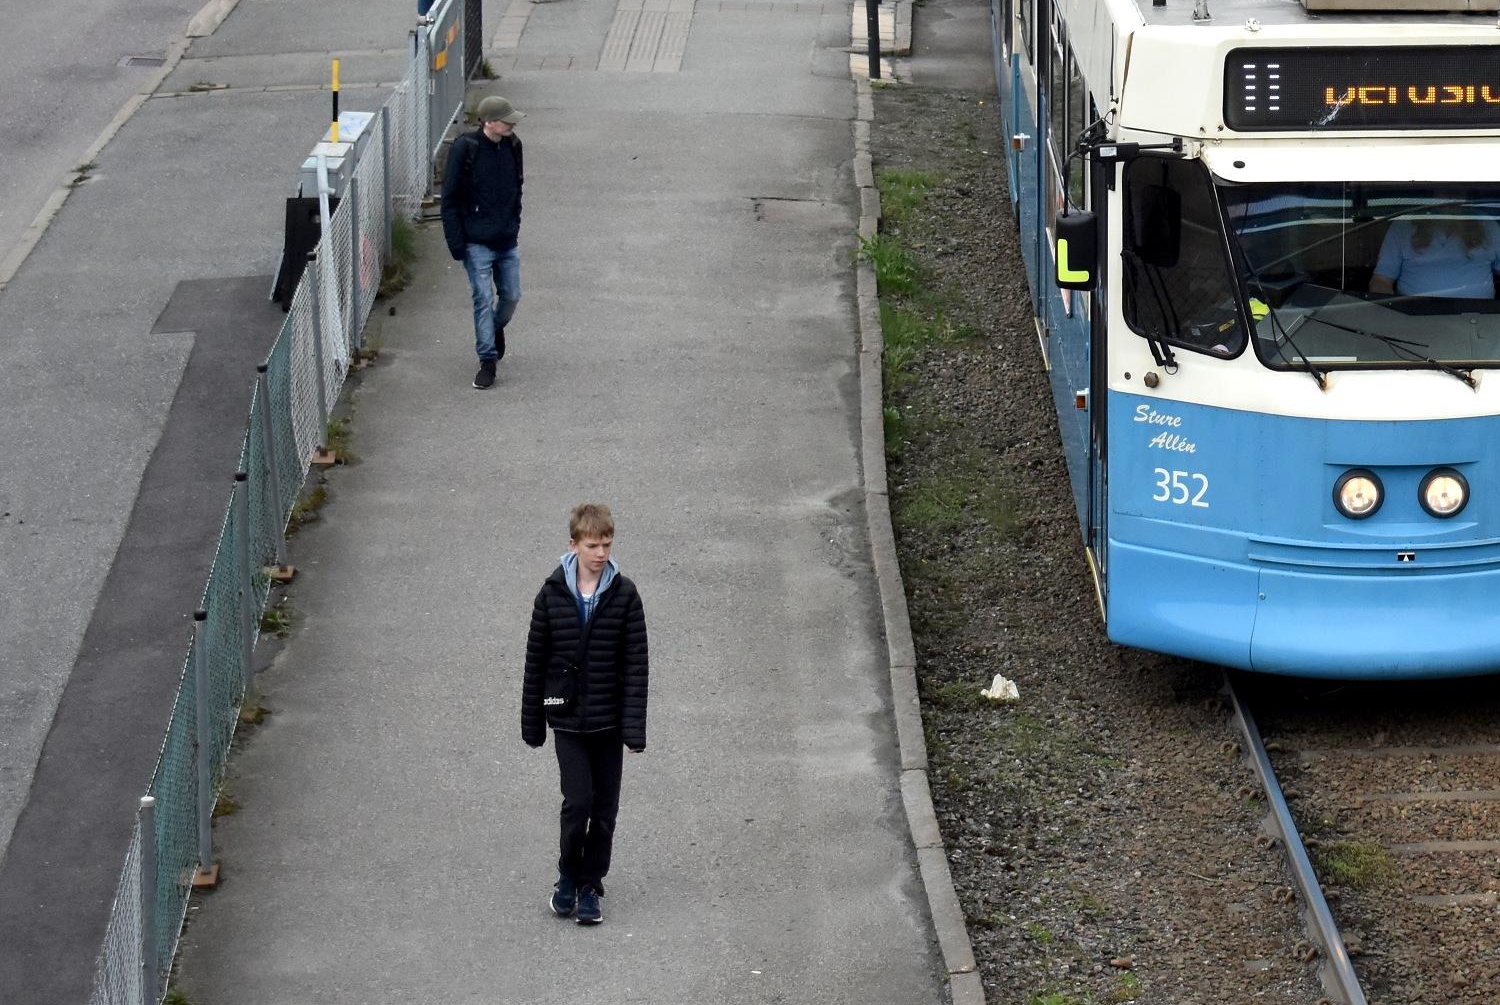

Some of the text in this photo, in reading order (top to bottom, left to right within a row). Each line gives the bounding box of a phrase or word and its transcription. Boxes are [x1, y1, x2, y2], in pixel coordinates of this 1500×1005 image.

[1133, 404, 1182, 427] Sture
[1148, 431, 1196, 453] Allén
[1153, 467, 1209, 508] 352
